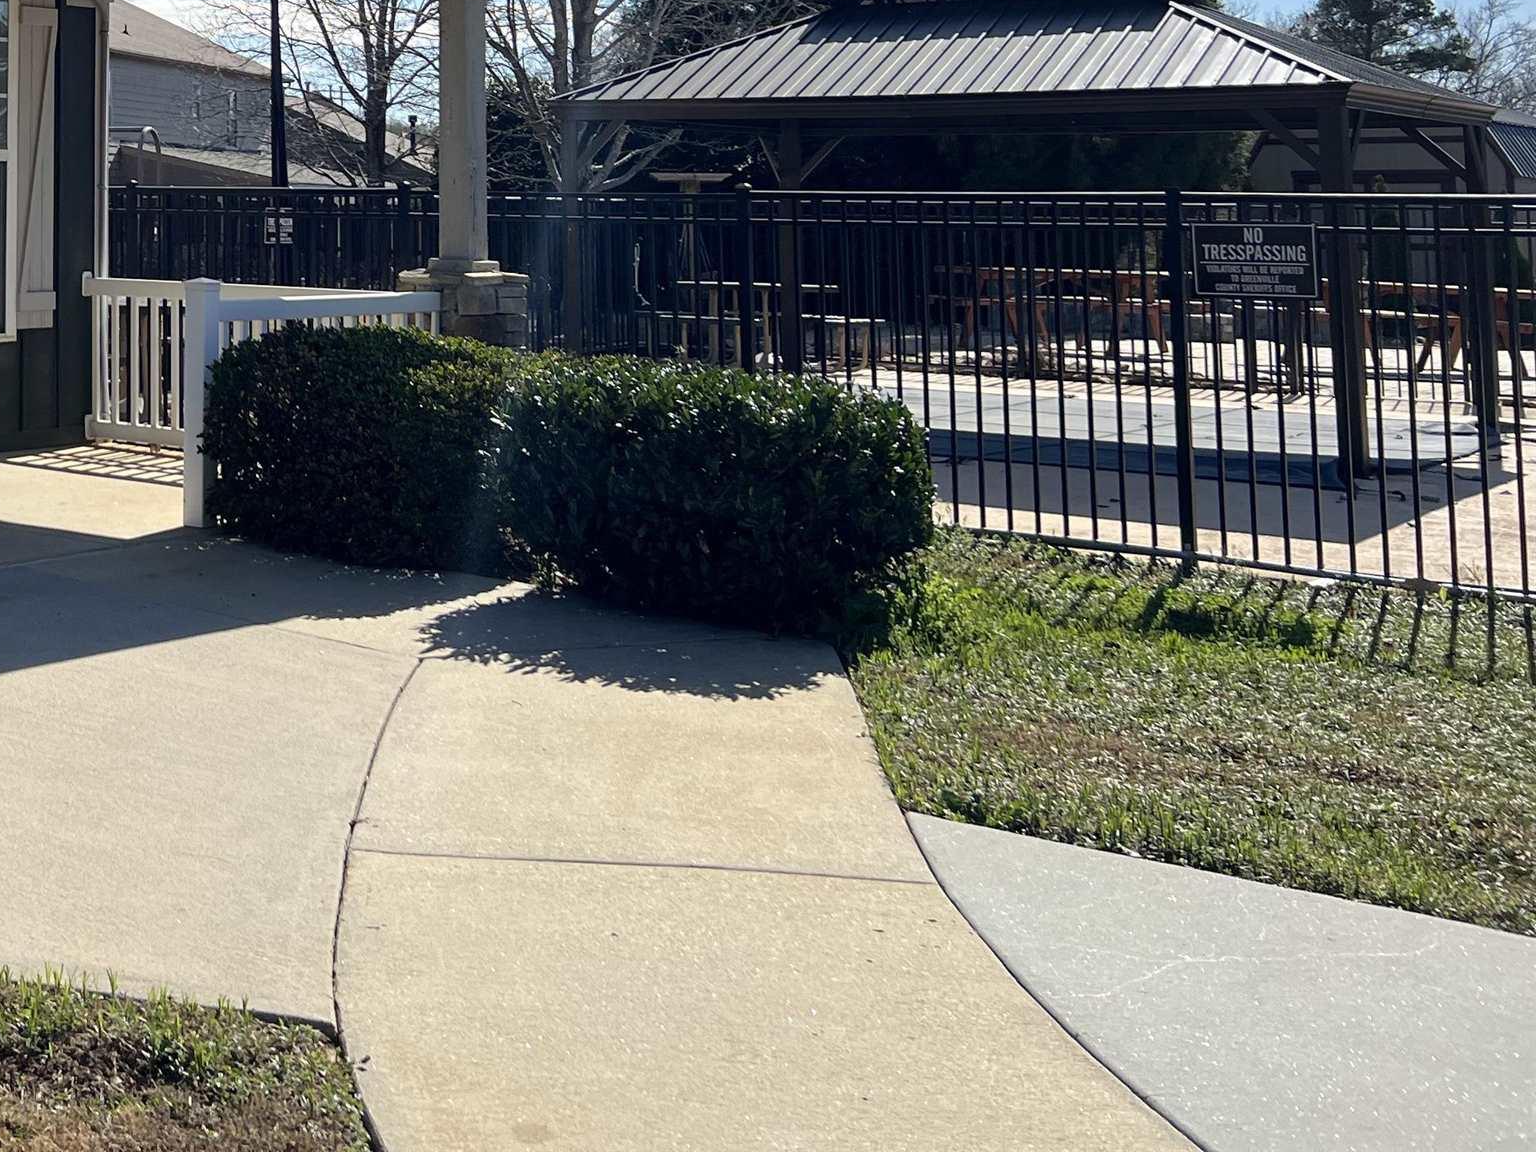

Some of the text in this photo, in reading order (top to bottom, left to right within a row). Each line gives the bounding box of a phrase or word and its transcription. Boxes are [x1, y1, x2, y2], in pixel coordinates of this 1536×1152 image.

[1244, 227, 1263, 244] NO
[1202, 244, 1307, 262] TRESSPASSING
[1242, 266, 1258, 274] WILL
[1231, 274, 1239, 282] TO
